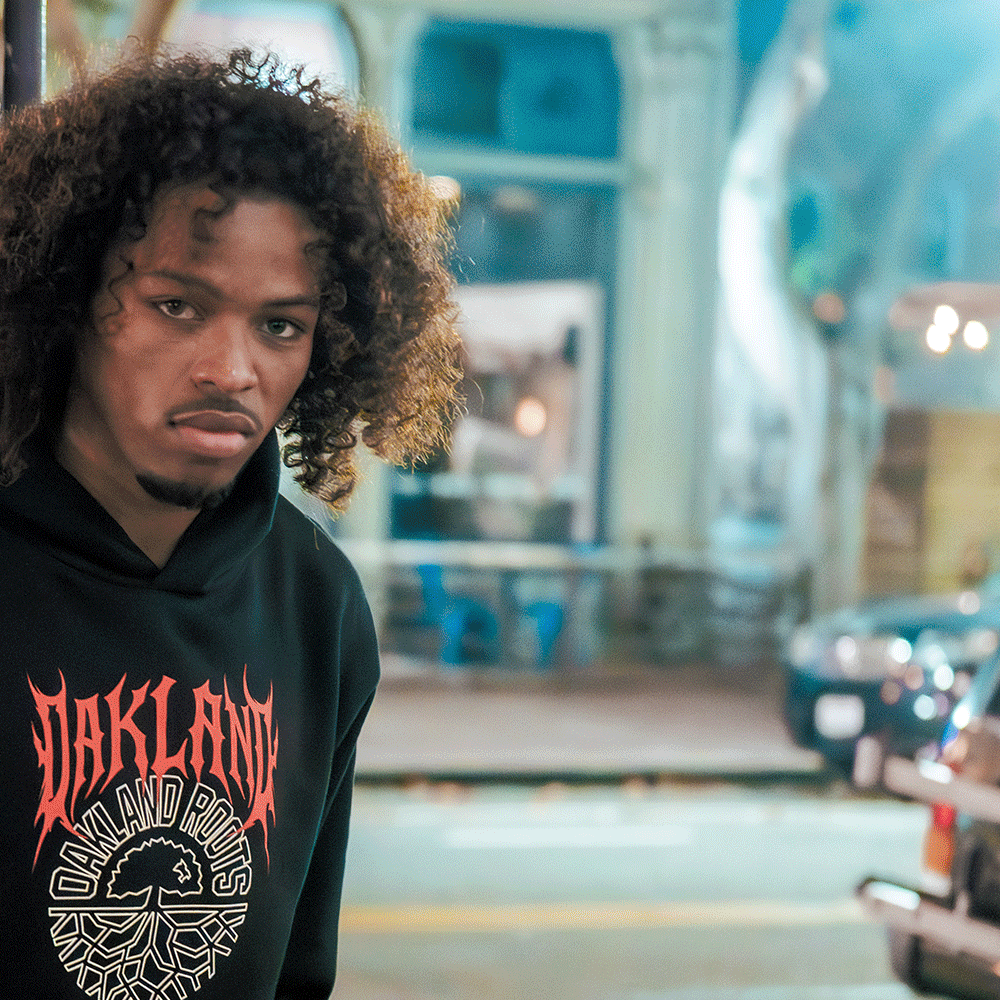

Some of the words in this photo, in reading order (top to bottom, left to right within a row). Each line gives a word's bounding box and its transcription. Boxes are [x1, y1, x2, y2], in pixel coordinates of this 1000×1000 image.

[26, 663, 279, 874] OAKLAND
[49, 775, 184, 900] OAKLAND
[179, 782, 254, 897] ROOTS
